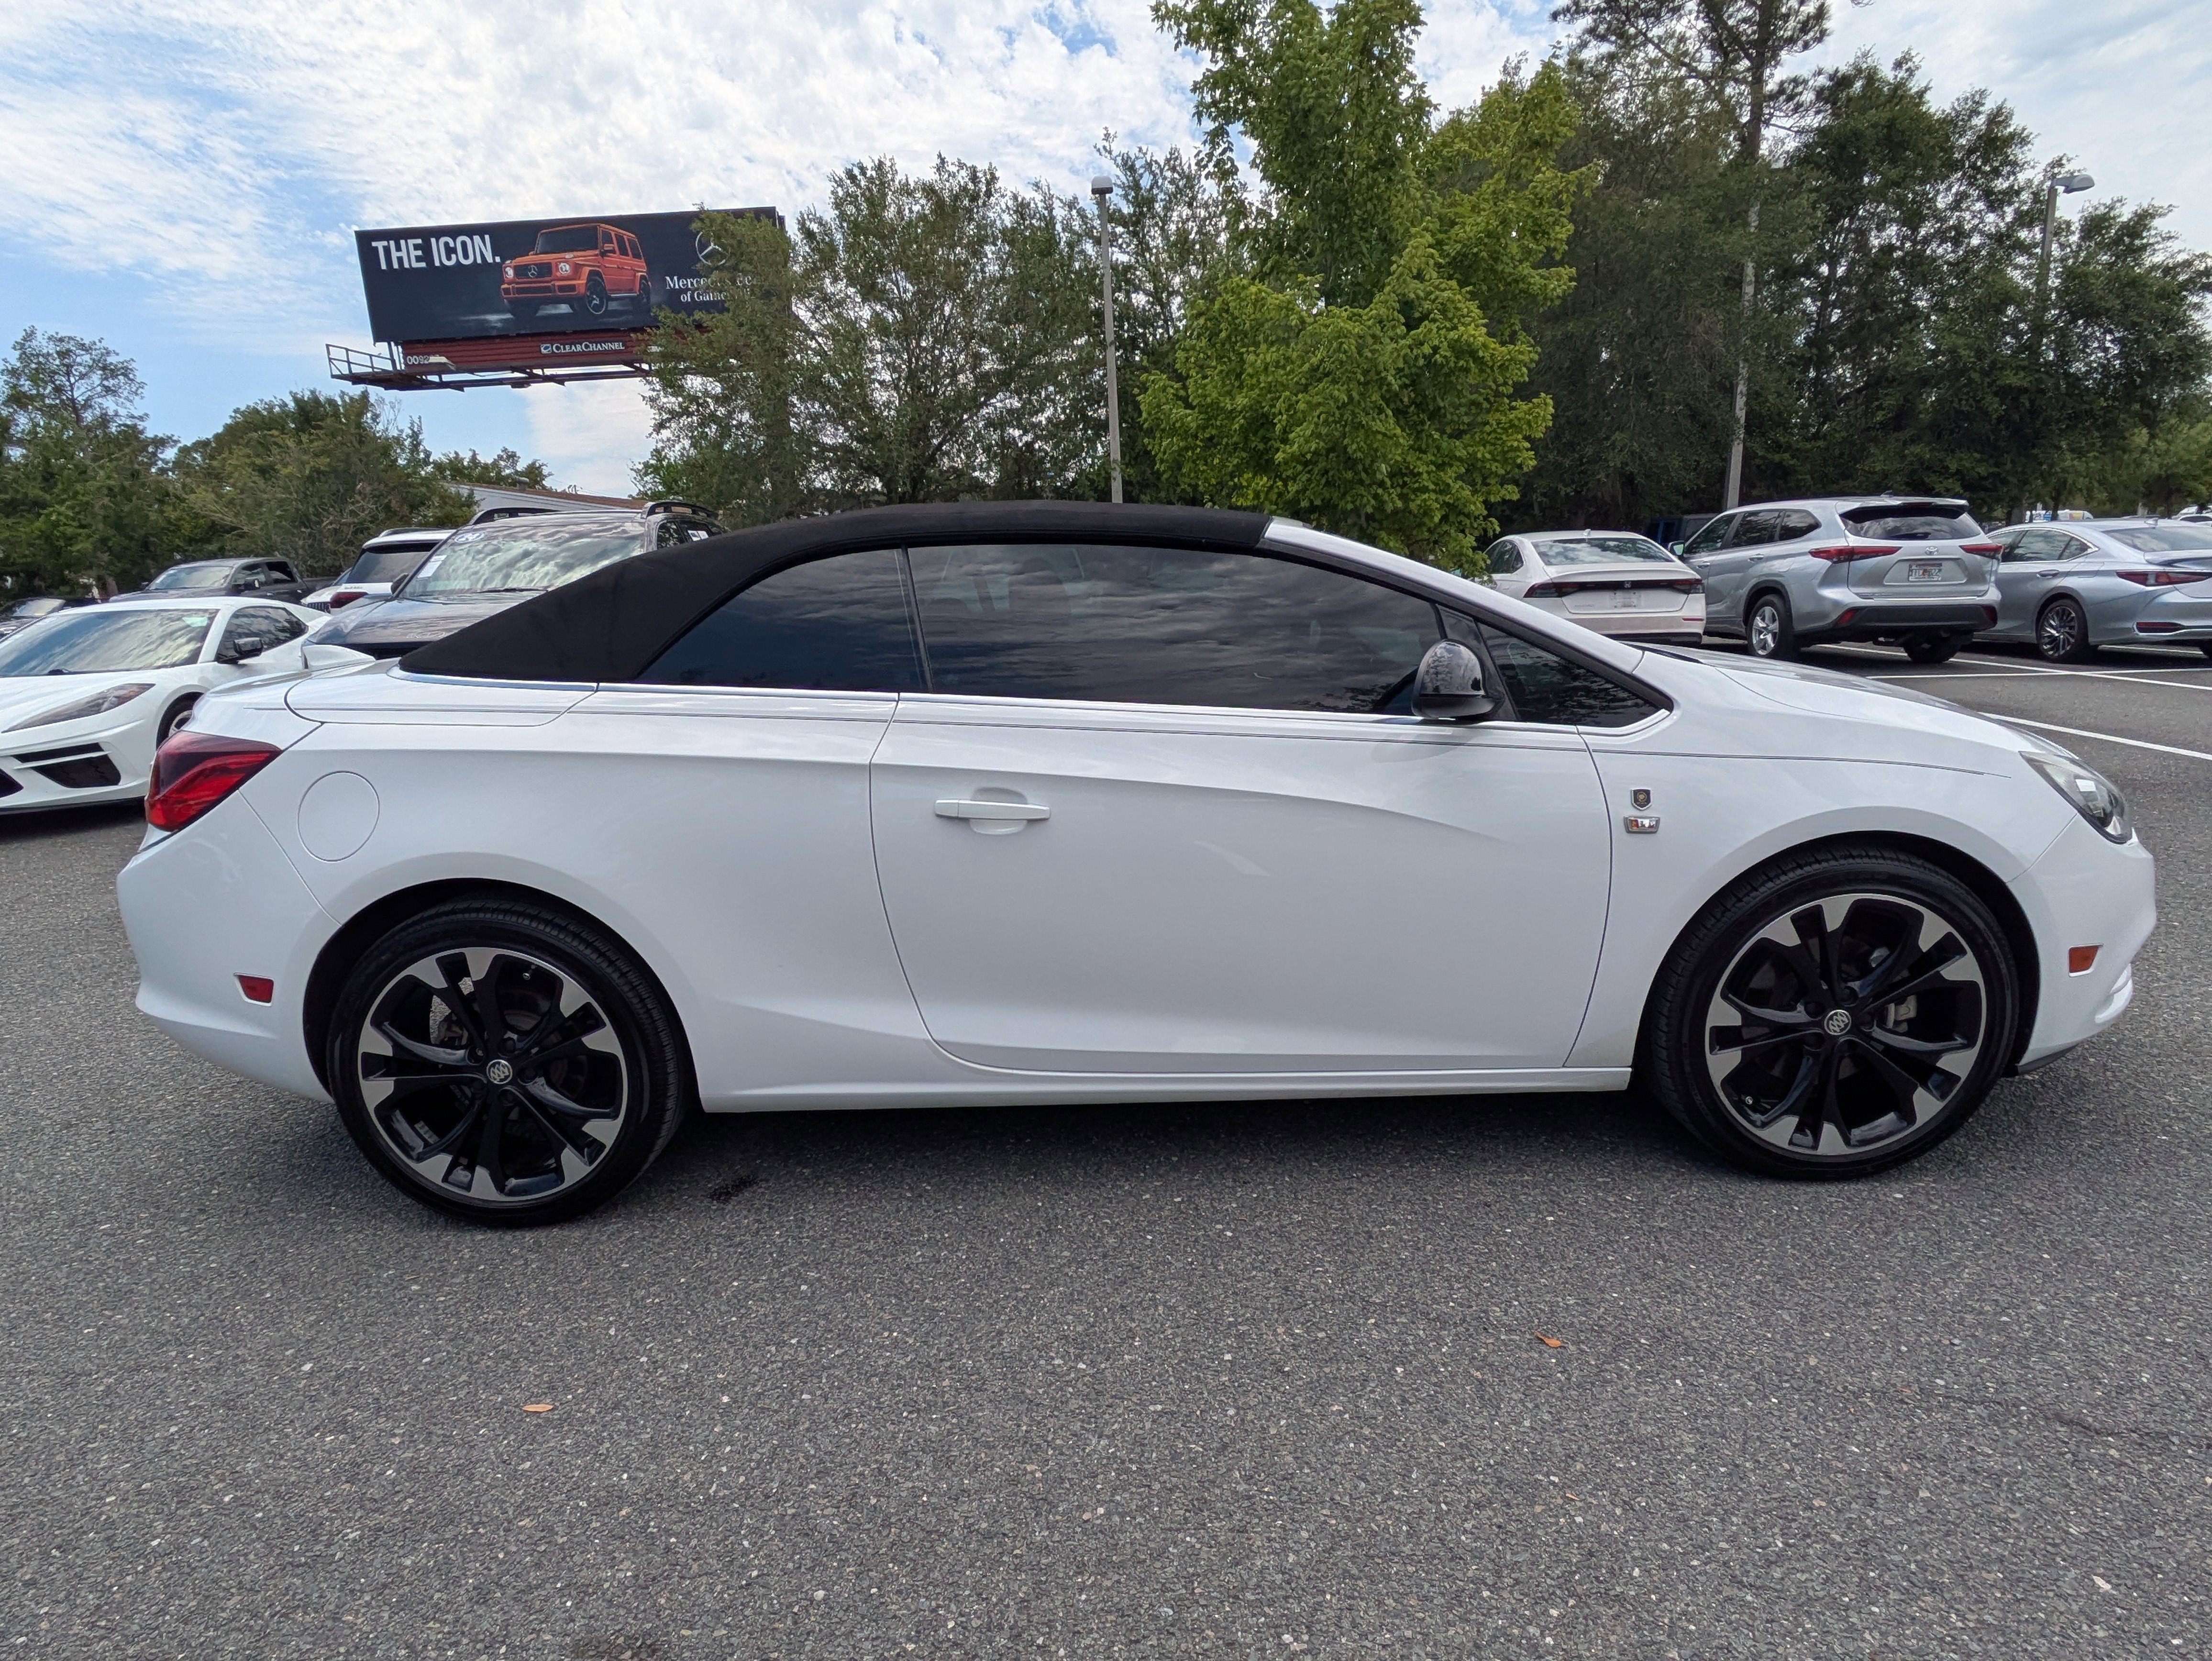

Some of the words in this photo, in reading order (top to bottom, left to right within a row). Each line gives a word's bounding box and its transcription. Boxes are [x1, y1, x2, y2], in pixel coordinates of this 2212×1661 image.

[372, 239, 427, 270] THE
[431, 234, 501, 266] ICON.
[680, 291, 692, 302] of
